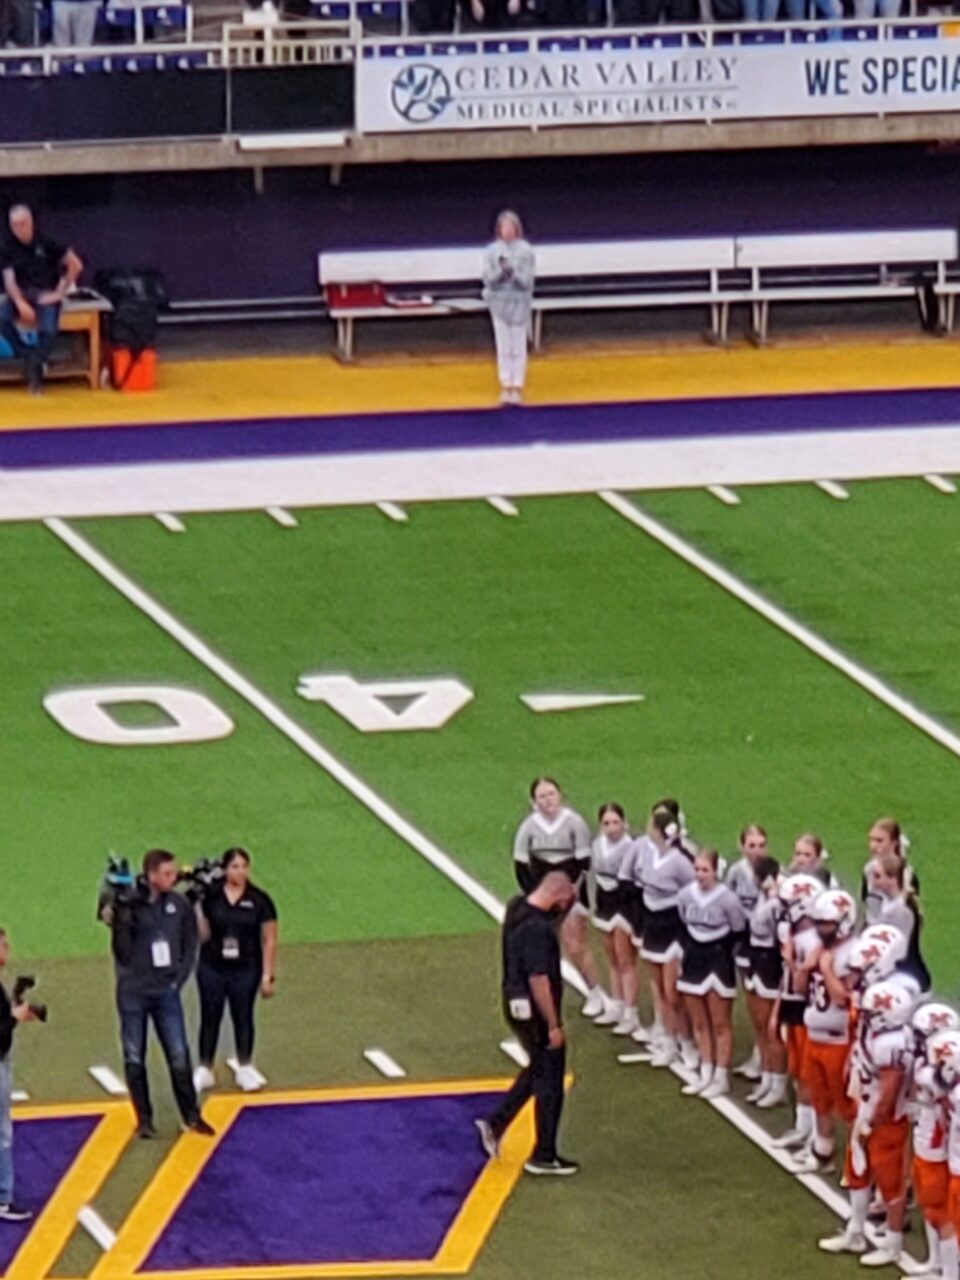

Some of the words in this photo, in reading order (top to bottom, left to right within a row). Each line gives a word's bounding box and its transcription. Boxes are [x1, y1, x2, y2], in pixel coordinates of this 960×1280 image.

[454, 59, 580, 90] CEDAR
[596, 57, 738, 84] VALLEY
[805, 59, 848, 96] WE
[457, 100, 563, 119] MEDICAL
[573, 96, 723, 117] SPECIALISTS
